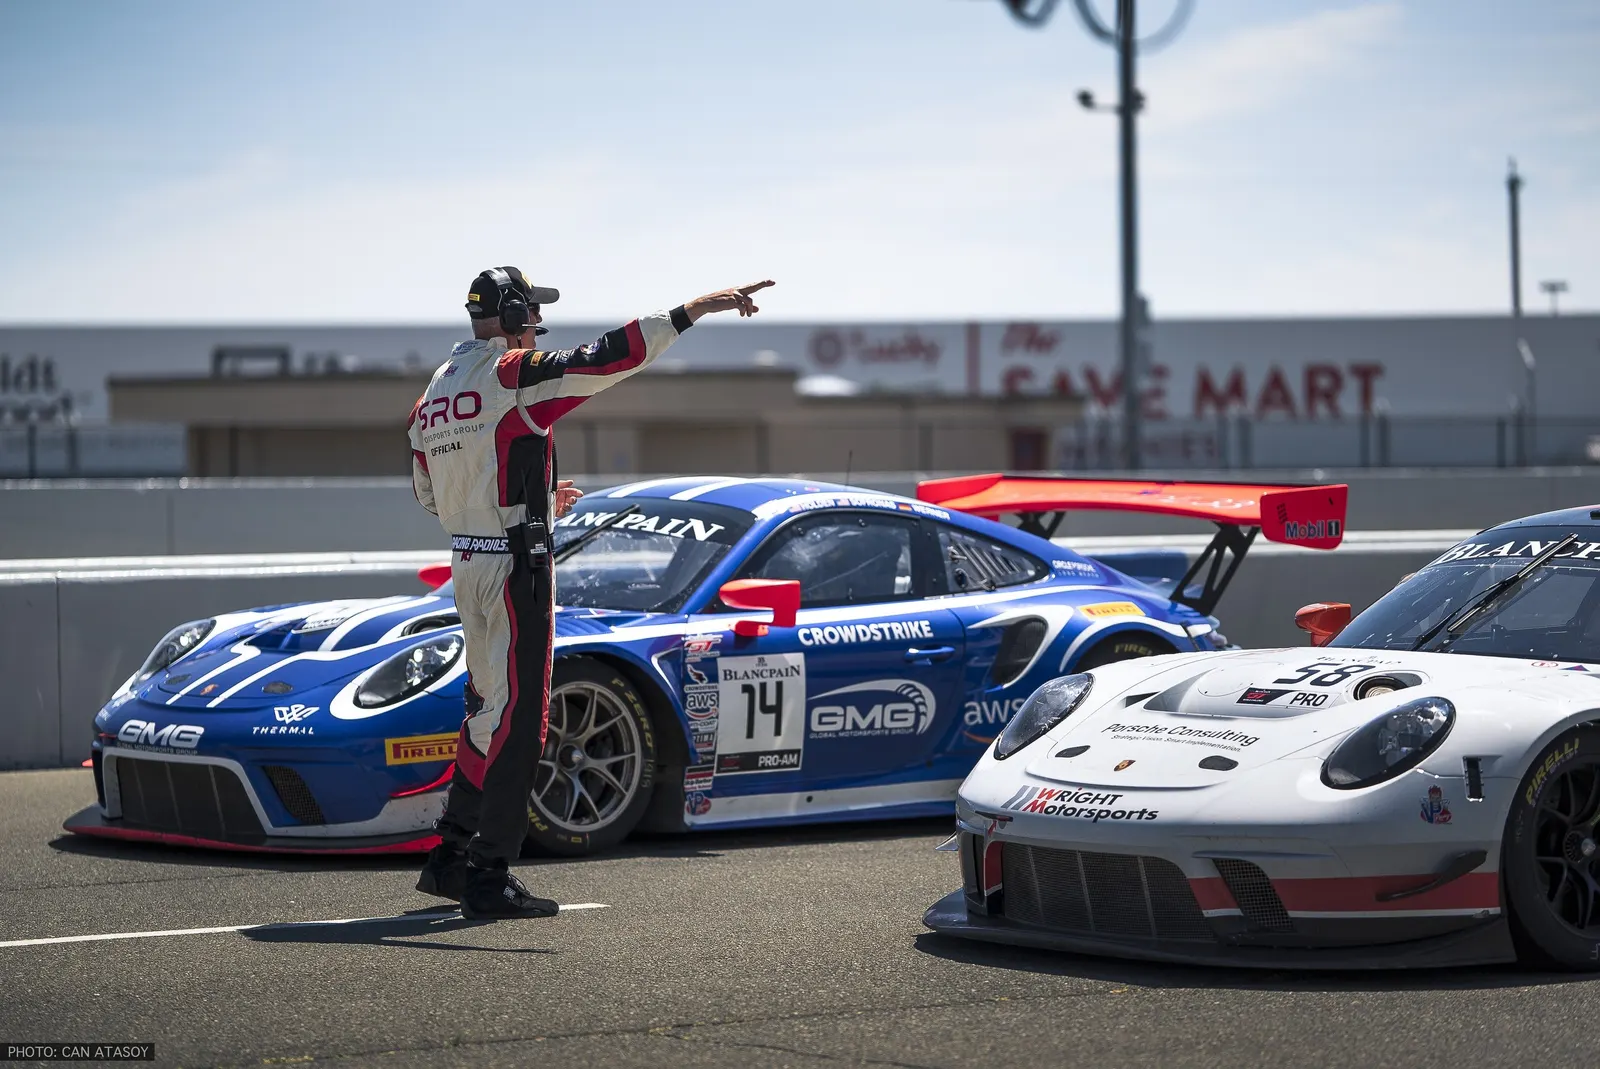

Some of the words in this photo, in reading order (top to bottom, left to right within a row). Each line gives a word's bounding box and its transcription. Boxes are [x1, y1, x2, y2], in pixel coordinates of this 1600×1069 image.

[1193, 360, 1386, 420] MART
[417, 390, 482, 432] SRO
[453, 423, 486, 436] GROUP
[430, 441, 463, 457] OFFICIAL
[1285, 519, 1326, 540] Mobil
[797, 619, 934, 646] CROWDSTRIKE
[722, 664, 801, 682] BLANCPAIN
[1272, 662, 1377, 687] 58
[687, 693, 717, 708] aws
[741, 680, 784, 740] 14
[1289, 692, 1329, 708] PRO
[810, 702, 917, 732] GMG
[117, 719, 205, 749] GMG
[252, 726, 315, 736] THERMAL
[1101, 723, 1168, 734] Porsche
[1168, 725, 1261, 748] Consulting
[392, 737, 458, 760] PIRELL
[757, 753, 798, 768] PRO-AM
[1525, 737, 1580, 805] PIRELLI
[1021, 799, 1160, 824] Motorsports
